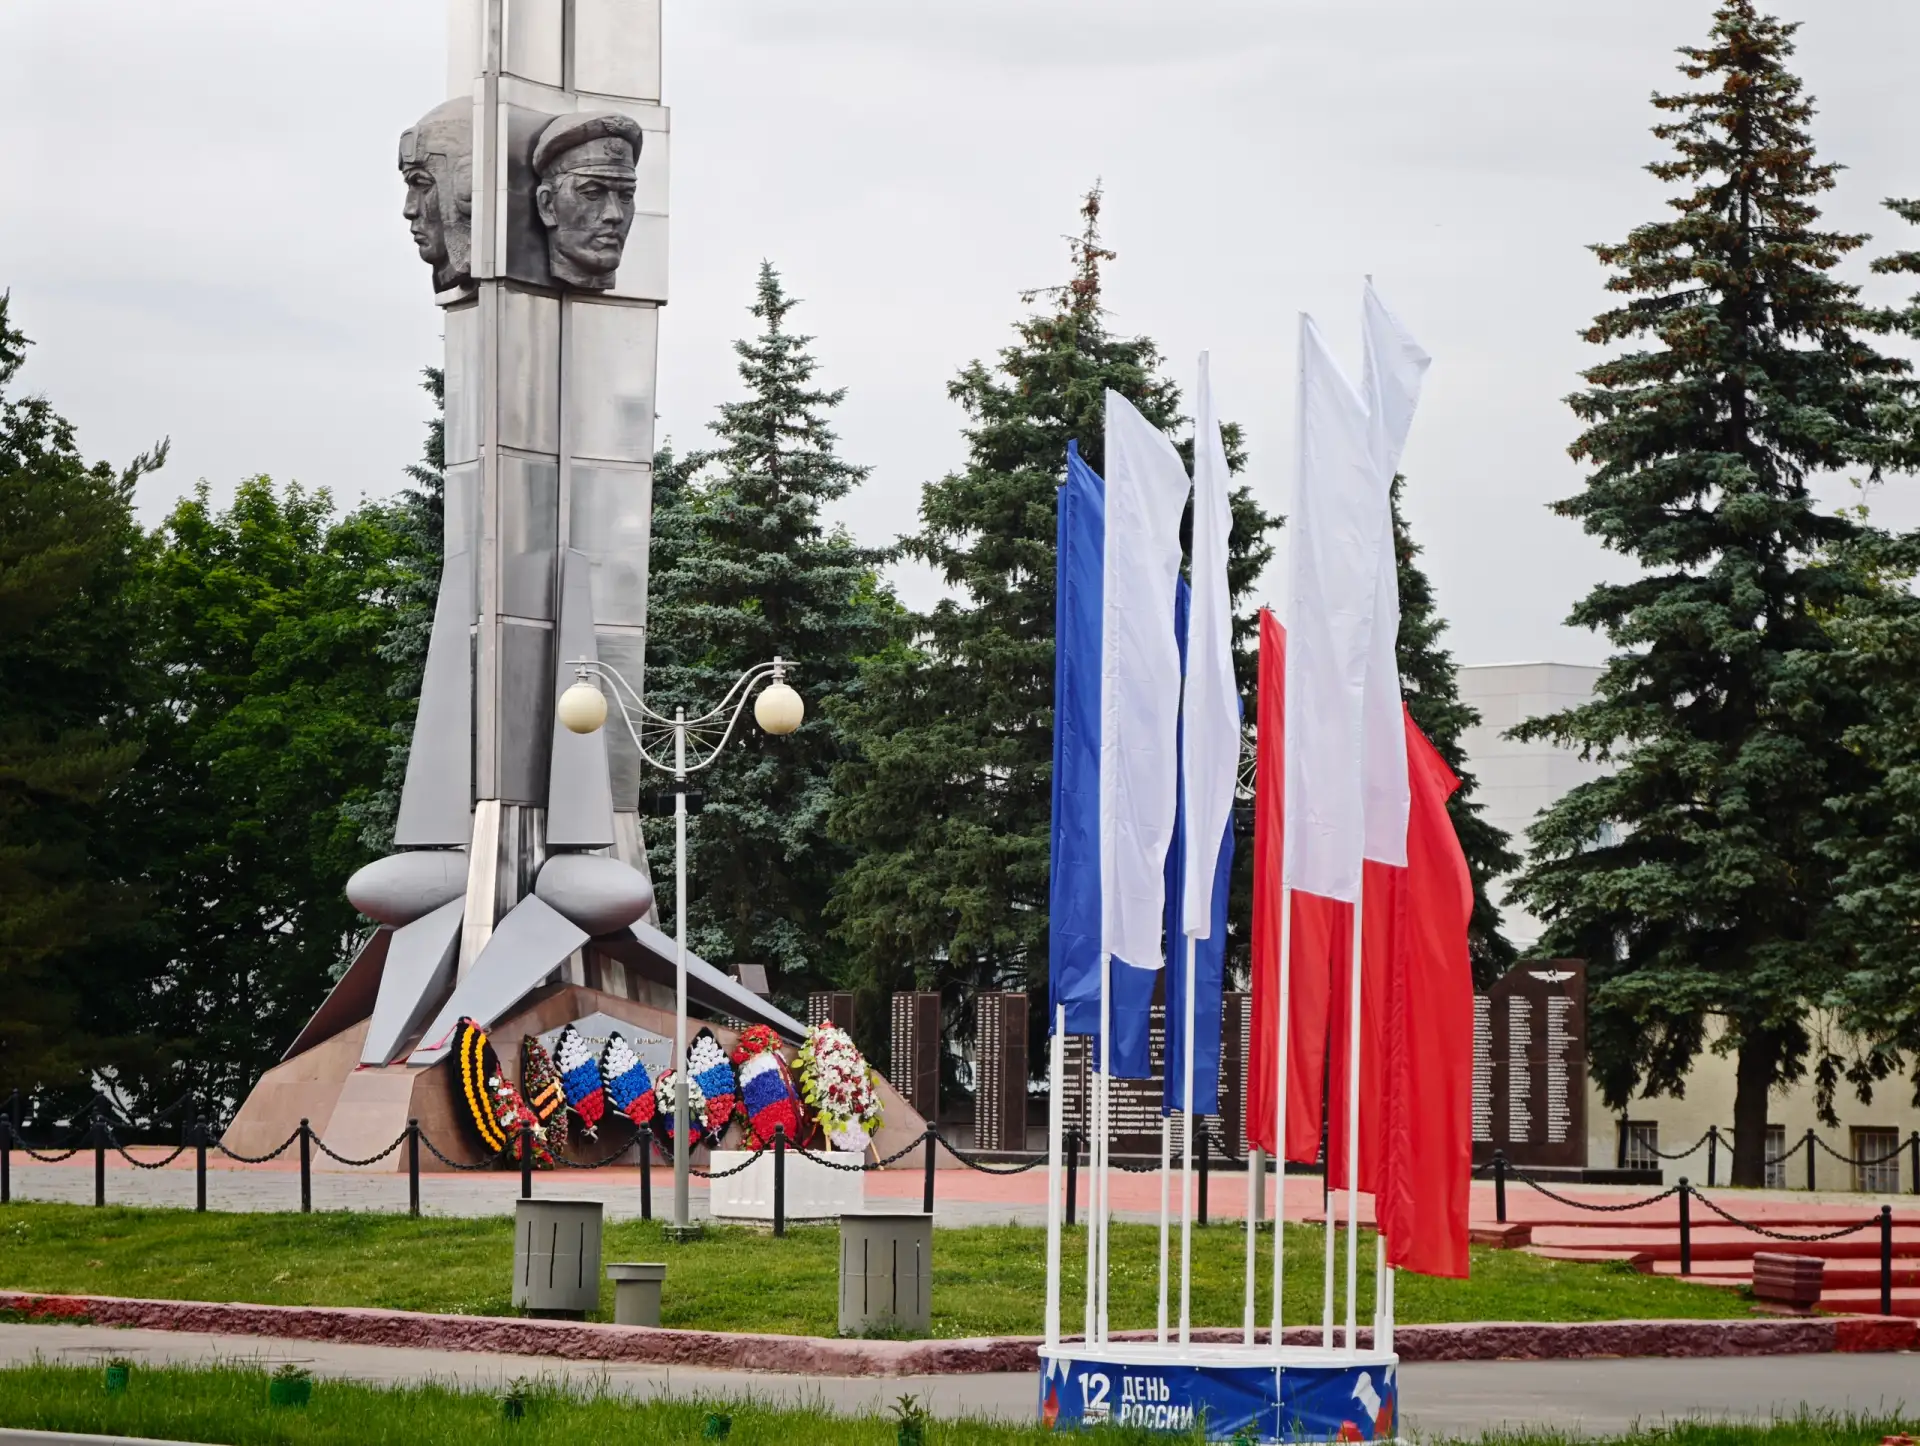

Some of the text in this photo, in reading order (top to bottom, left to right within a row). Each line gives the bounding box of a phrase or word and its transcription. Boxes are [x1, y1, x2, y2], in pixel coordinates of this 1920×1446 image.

[1078, 1372, 1111, 1410] 12
[1122, 1376, 1170, 1403] ДЕНЬ
[1121, 1403, 1194, 1429] РОССИИ
